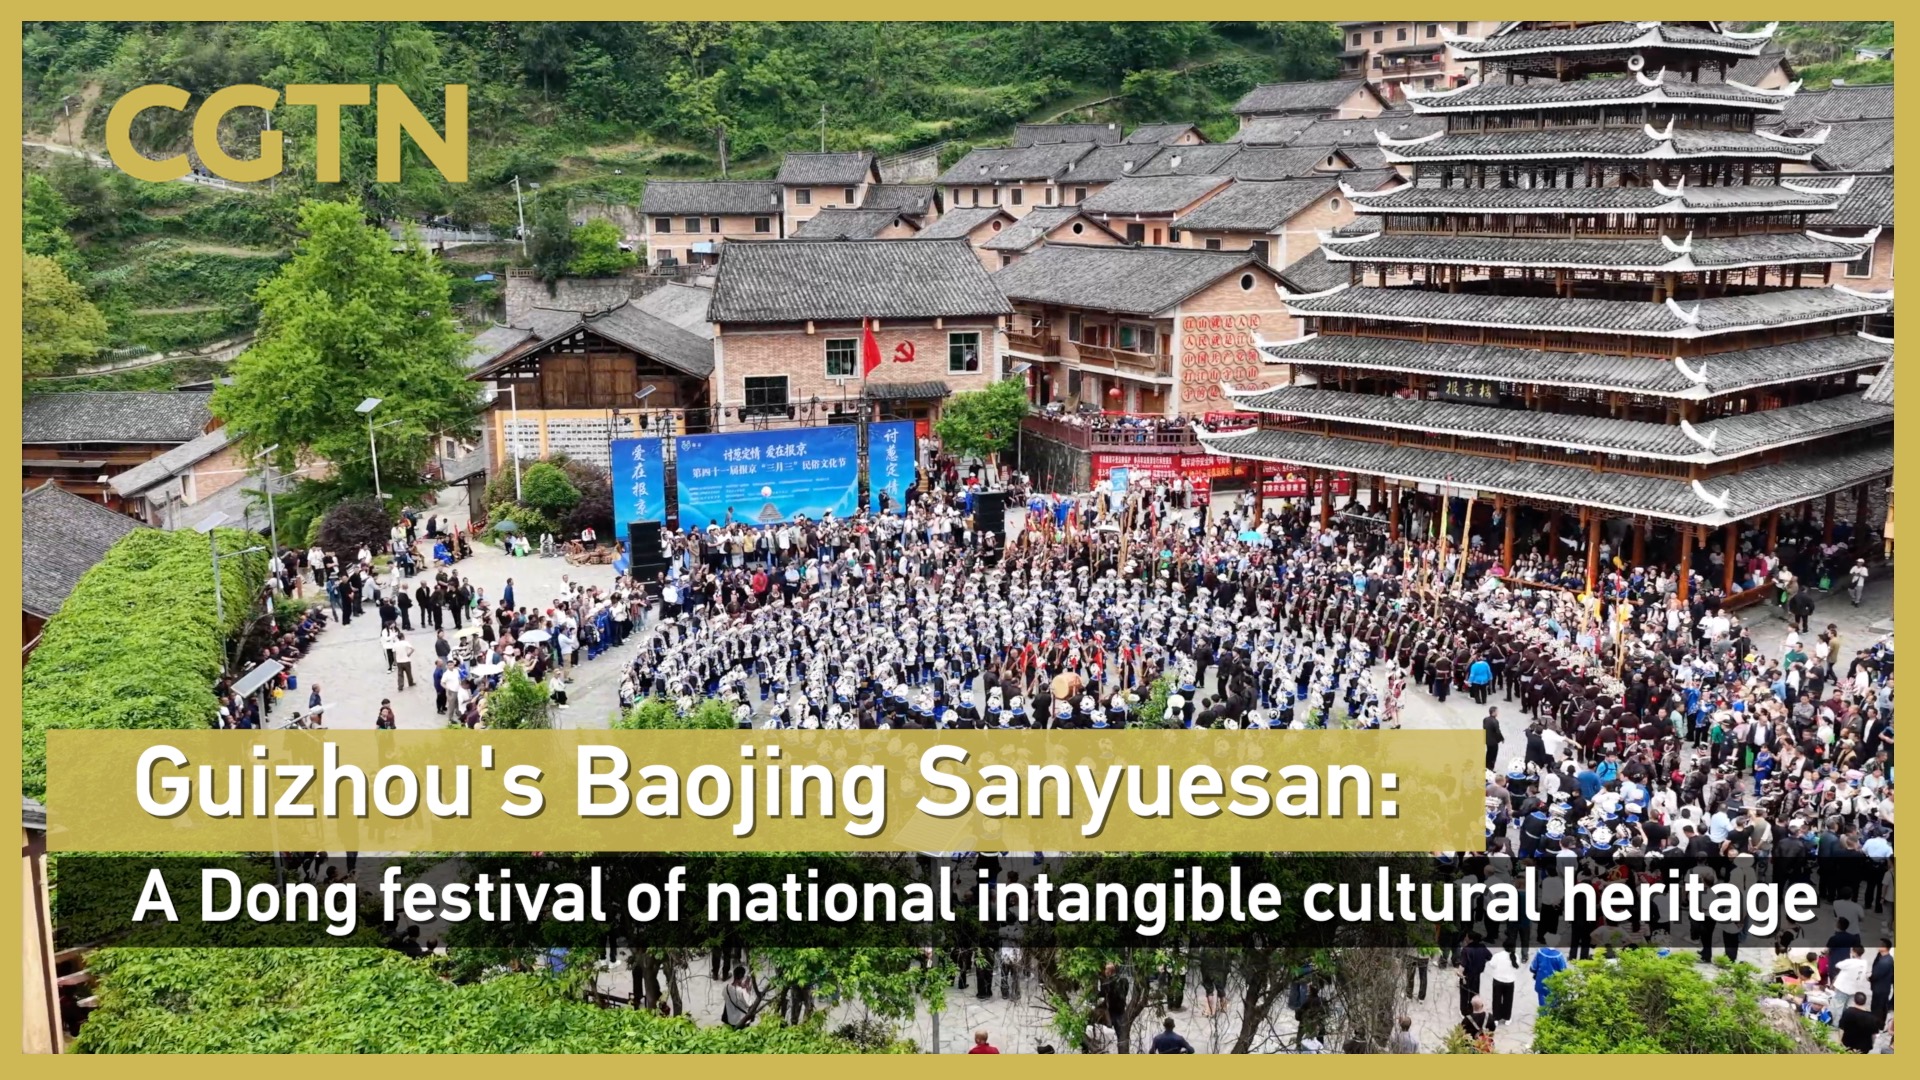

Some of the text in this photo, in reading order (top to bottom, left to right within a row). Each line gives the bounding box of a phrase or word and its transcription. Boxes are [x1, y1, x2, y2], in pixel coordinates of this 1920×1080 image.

[1185, 317, 1258, 329] 江山就是人民
[765, 441, 807, 459] 爱在报京
[632, 444, 649, 515] 爱在报京
